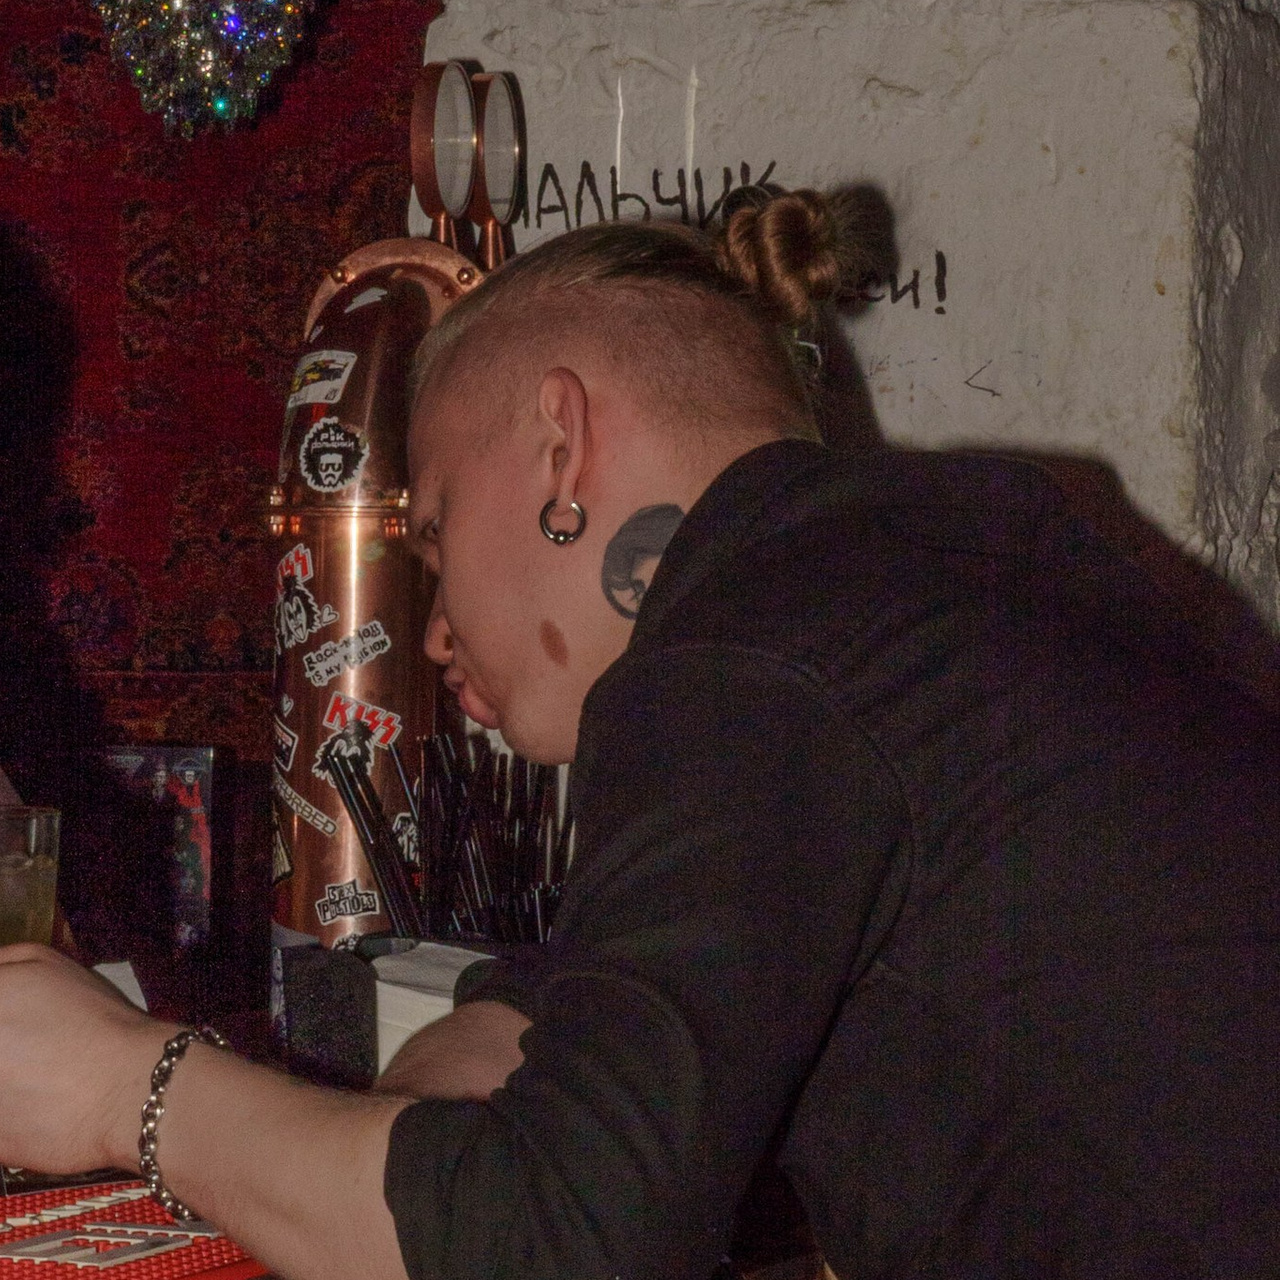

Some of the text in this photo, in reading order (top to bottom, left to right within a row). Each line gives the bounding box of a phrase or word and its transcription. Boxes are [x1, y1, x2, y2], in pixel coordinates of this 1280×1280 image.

[520, 160, 776, 228] АЛЬЧИ
[279, 549, 309, 578] ISS
[326, 696, 397, 745] KISS
